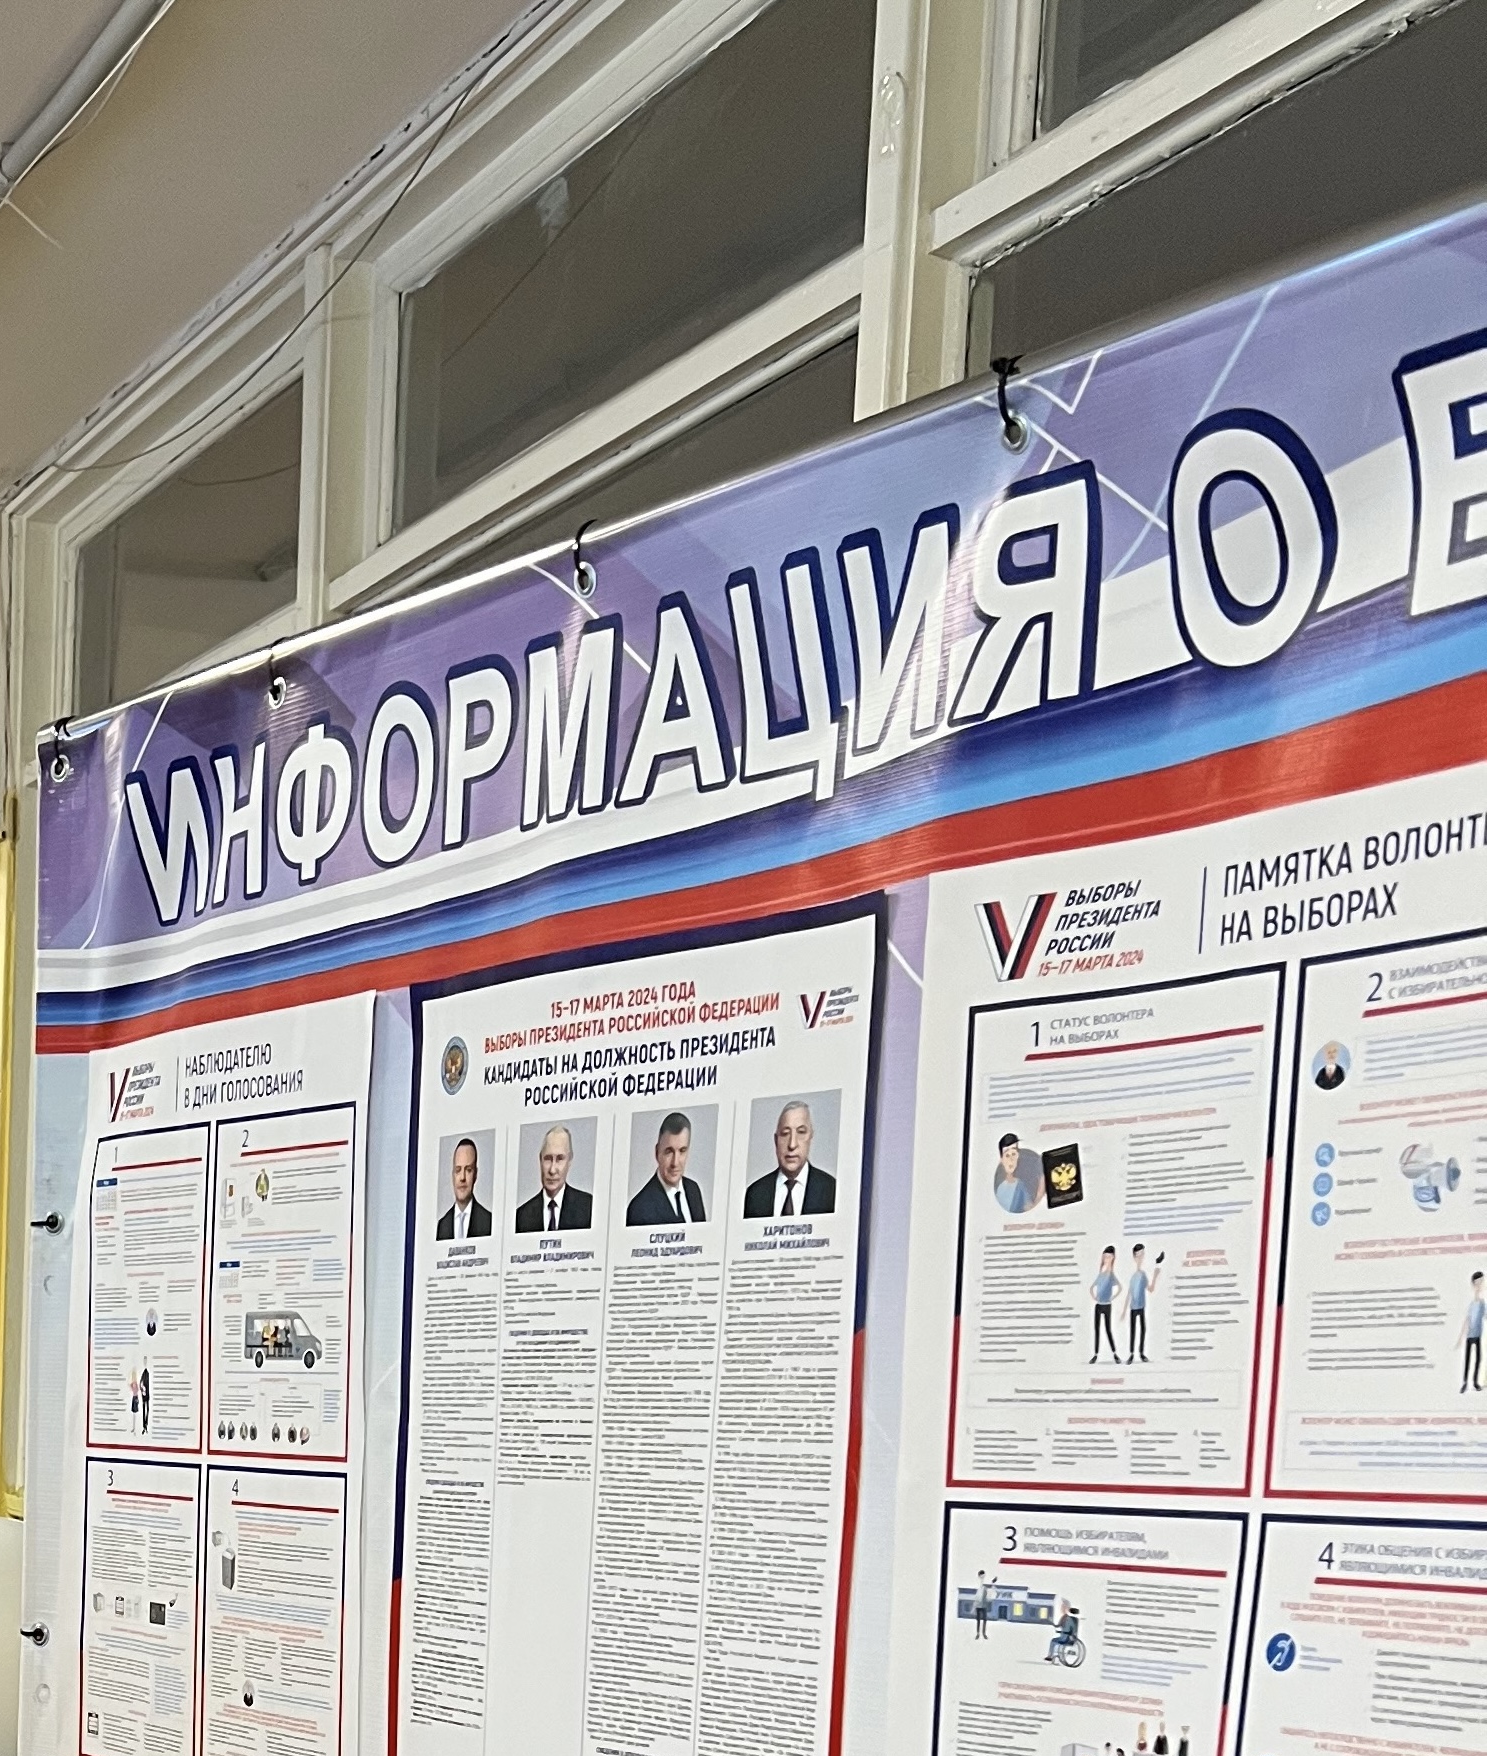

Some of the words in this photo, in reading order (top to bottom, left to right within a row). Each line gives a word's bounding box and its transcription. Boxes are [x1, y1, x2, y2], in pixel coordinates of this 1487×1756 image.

[125, 460, 1102, 925] ИНФОРМАЦИЯ
[1168, 408, 1338, 667] О
[1223, 842, 1352, 898] ПАМЯТКА
[1364, 812, 1487, 870] ВОЛОНТ
[1064, 879, 1142, 908] ВЫБОРЫ
[1054, 900, 1162, 932] ПРЕЗИДЕНТА
[1221, 909, 1252, 946] НА
[1263, 882, 1398, 938] ВЫБОРАХ
[1045, 931, 1116, 956] РОССИИ
[1072, 954, 1114, 974] МАРТА
[1116, 949, 1144, 968] 2024
[551, 998, 581, 1019] 15-17
[582, 992, 624, 1014] МАРТА
[627, 986, 658, 1007] 2024
[661, 980, 696, 1003] ГОДА
[1366, 972, 1383, 1002] 2
[484, 1029, 527, 1054] ВЫБОРЫ
[529, 1018, 605, 1046] ПРЕЗИДЕНТА
[608, 1001, 696, 1034] РОССИЙСКОЙ
[698, 992, 780, 1023] ФЕДЕРАЦИИ
[1030, 1021, 1040, 1047] 1
[1050, 1015, 1090, 1030] СТАТУС
[1050, 1034, 1066, 1046] НА
[1069, 1029, 1119, 1045] ВЫБОРАХ
[185, 1043, 271, 1078] НАБЛЮДАТЕЛЮ
[483, 1056, 557, 1085] КАНДИДАТЫ
[561, 1053, 578, 1074] НА
[581, 1041, 676, 1075] ДОЛЖНОСТЬ
[680, 1026, 776, 1059] ПРЕЗИДЕНТА
[184, 1087, 190, 1108] В
[193, 1084, 217, 1109] ДНИ
[220, 1069, 303, 1103] ГОЛОСОВАНИЯ
[524, 1072, 618, 1107] РОССИЙСКОЙ
[622, 1065, 717, 1096] ФЕДЕРАЦИИ
[242, 1129, 249, 1148] 2
[650, 1230, 685, 1244] СЛУЦКИЙ
[763, 1223, 813, 1237] ХАРИТОНОВ
[107, 1469, 114, 1486] 3
[232, 1478, 239, 1496] 4
[1002, 1526, 1017, 1551] 3
[1318, 1542, 1334, 1570] 4
